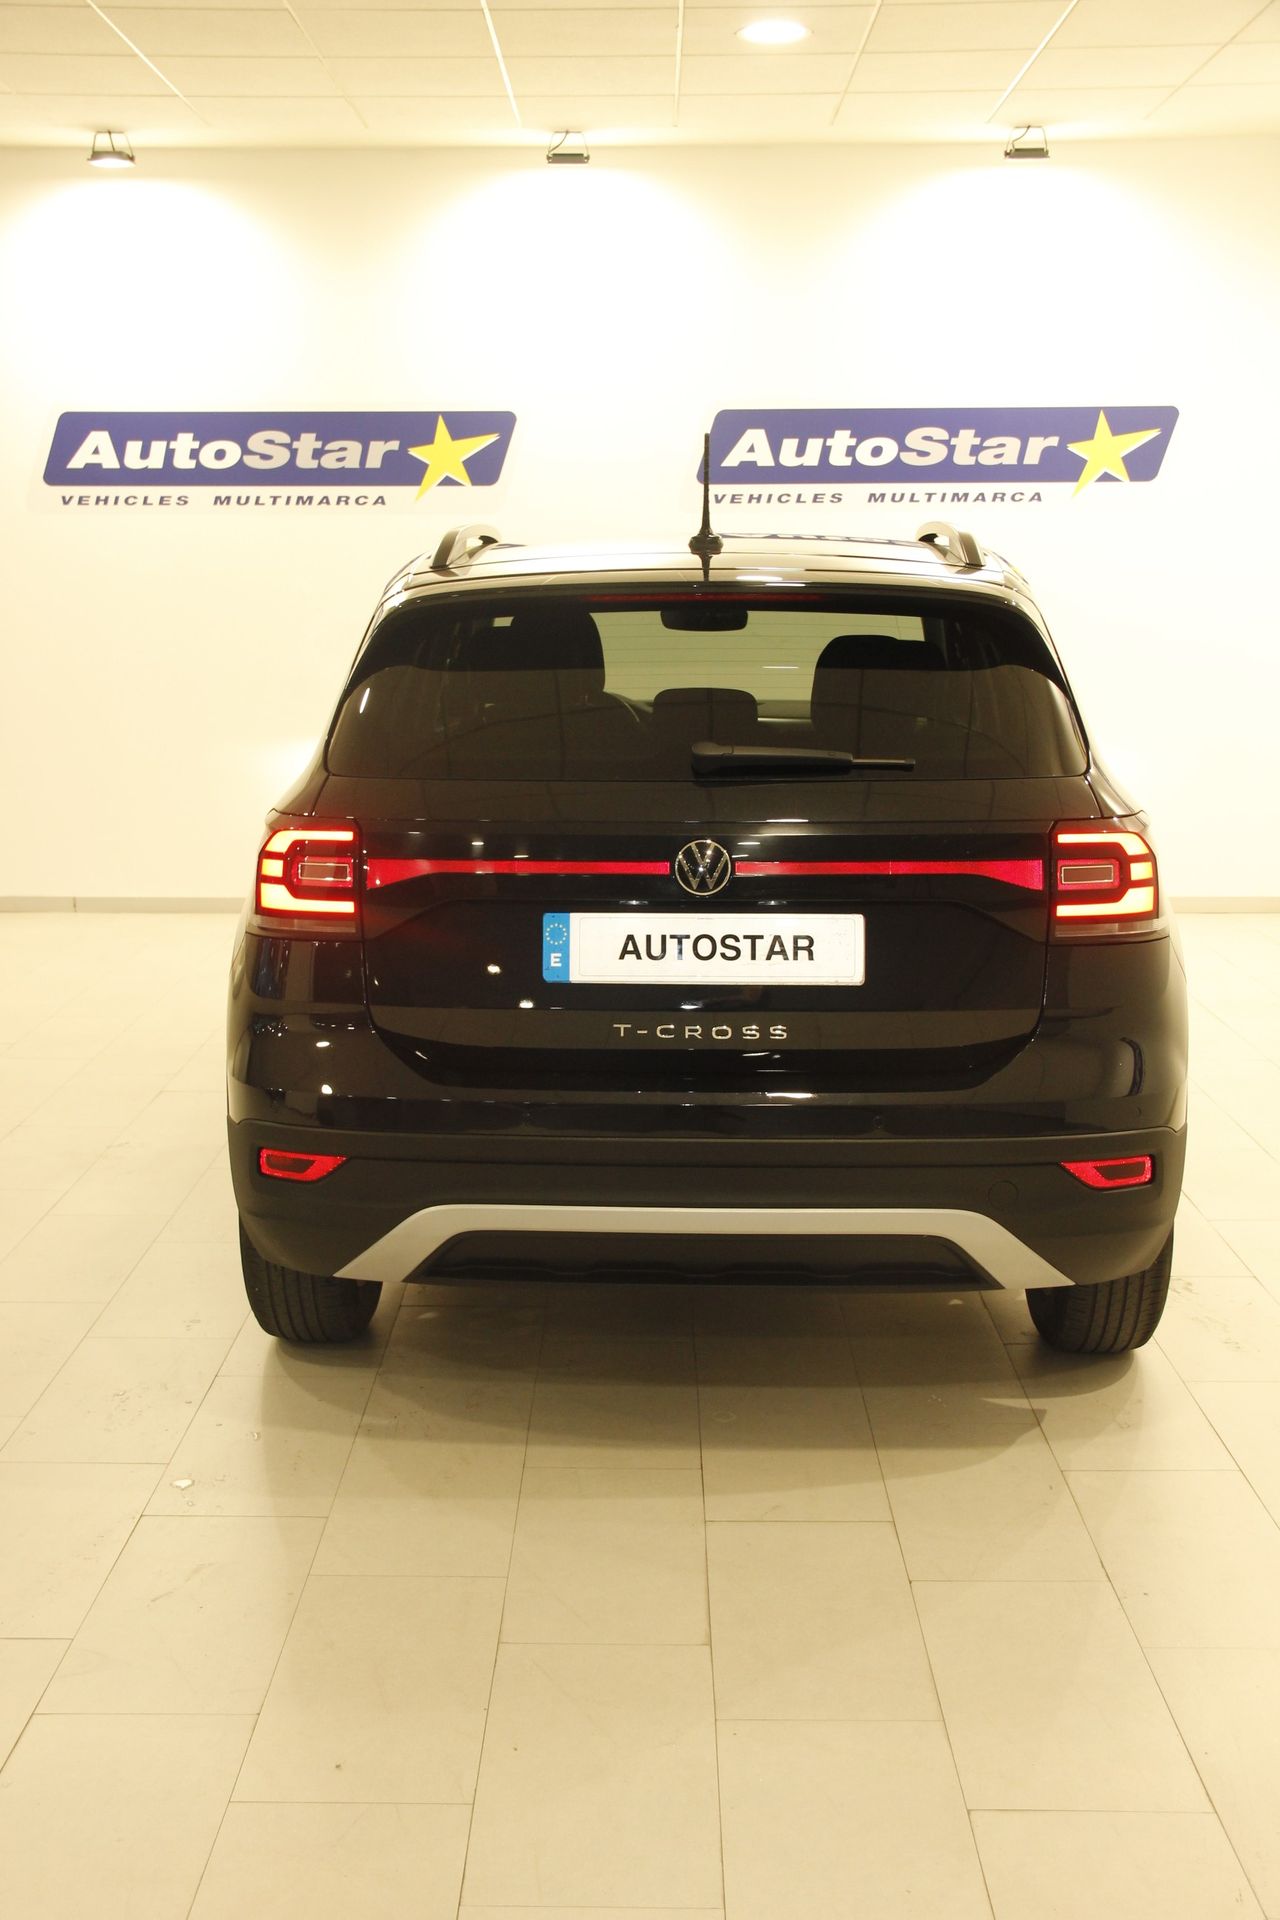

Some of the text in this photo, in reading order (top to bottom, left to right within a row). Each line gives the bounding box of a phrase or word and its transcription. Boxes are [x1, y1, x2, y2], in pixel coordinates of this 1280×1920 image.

[66, 430, 400, 470] AutoStar
[720, 426, 1060, 467] AutoStar
[61, 495, 387, 507] VEHICLES MULTIMARCA
[713, 491, 1043, 504] VEHICLES MULTIMARCA
[618, 933, 815, 962] AUTOSTAR
[549, 952, 562, 967] E
[612, 1022, 788, 1040] T-CROSS
